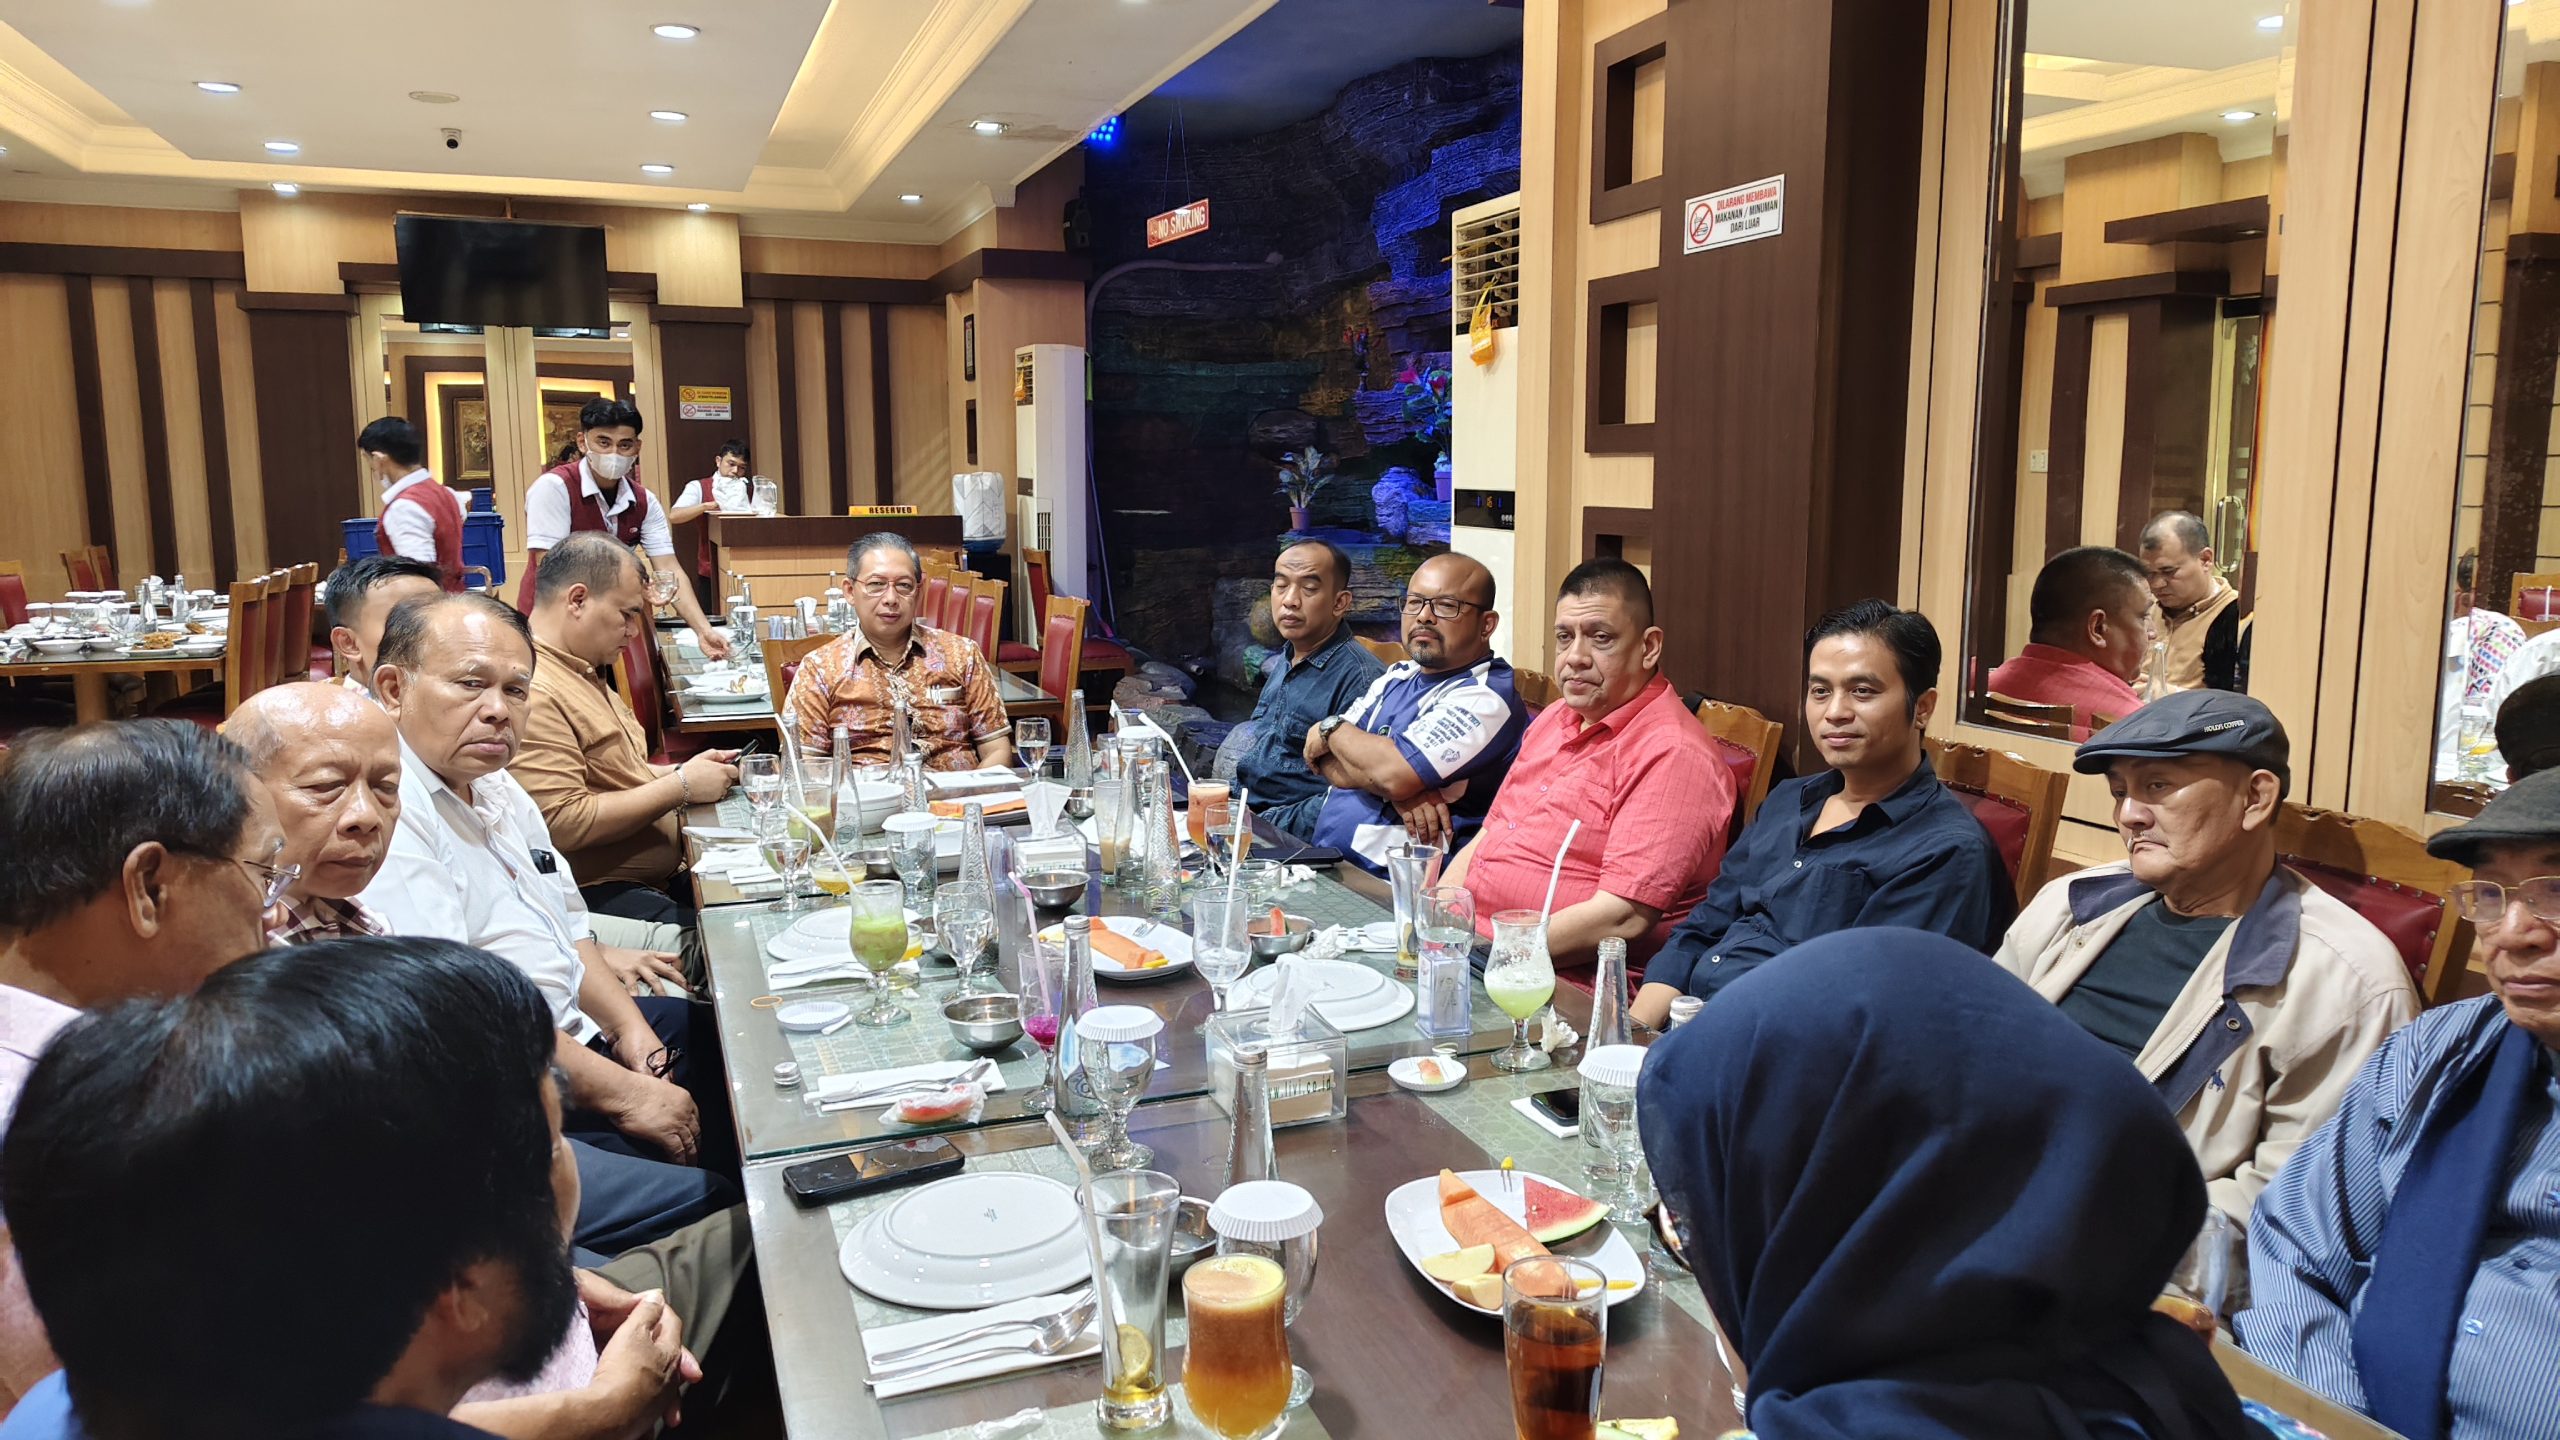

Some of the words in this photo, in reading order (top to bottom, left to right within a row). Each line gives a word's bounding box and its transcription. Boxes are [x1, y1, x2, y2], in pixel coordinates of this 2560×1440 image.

[1716, 194, 1745, 211] DILARANG
[1745, 186, 1778, 205] MEMBAWA
[1158, 217, 1169, 239] NO
[1170, 205, 1206, 235] SMOKING
[1714, 208, 1743, 223] MAKANAN
[1749, 199, 1779, 217] MINUMAN
[1730, 219, 1745, 234] DARI
[1744, 216, 1761, 231] LUAR
[868, 506, 913, 514] RESERVED
